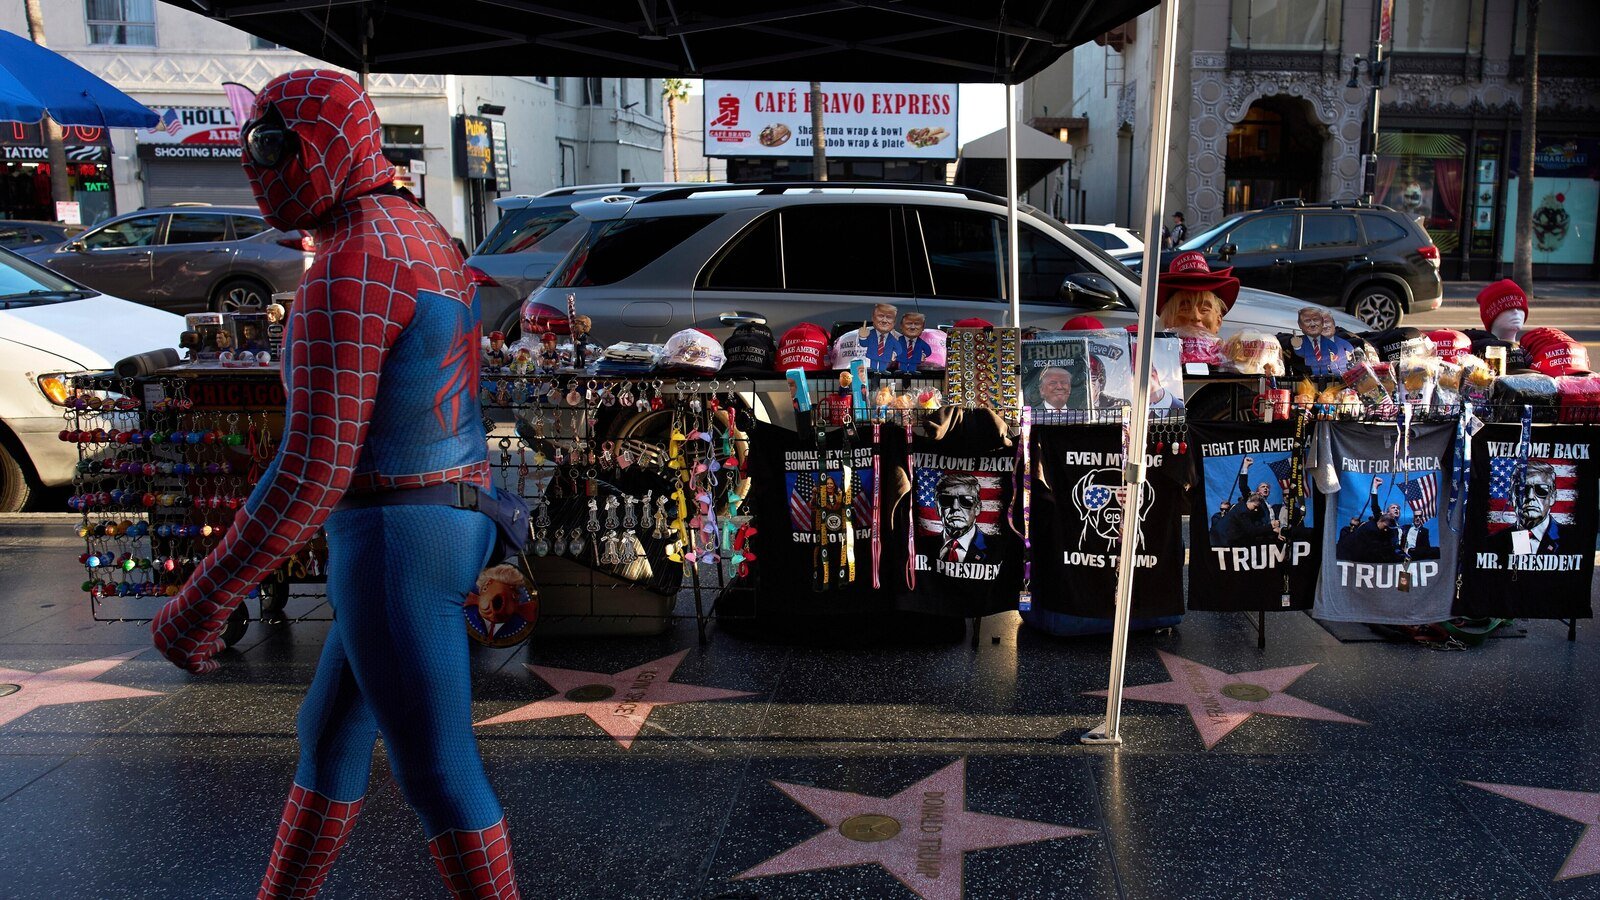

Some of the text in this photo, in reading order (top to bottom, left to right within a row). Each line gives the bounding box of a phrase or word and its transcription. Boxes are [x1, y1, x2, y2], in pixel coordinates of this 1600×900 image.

[755, 88, 797, 113] CAFÉ
[871, 93, 951, 115] EXPRESS
[208, 130, 241, 141] AIR
[798, 125, 903, 137] Shaerma wrap & bowl
[824, 138, 845, 147] abob
[847, 139, 870, 149] wrap
[872, 139, 879, 148] &
[882, 138, 905, 148] plate
[154, 147, 242, 158] SHOOTING RANG
[1497, 294, 1524, 305] AMERICA
[1504, 300, 1522, 309] AGAIN
[741, 346, 767, 357] AMERICA
[780, 345, 820, 357] MAKE AMERICA
[1024, 344, 1080, 360] TRUMP
[1088, 343, 1107, 354] lieve
[1383, 342, 1401, 353] MAKE
[1437, 349, 1456, 357] GREAT
[746, 355, 764, 364] AGAIN
[782, 355, 818, 365] GREAT AGAIN
[1545, 348, 1566, 360] MAKE
[1033, 359, 1075, 368] 2025 CALENDAR
[1549, 357, 1572, 368] GREAT
[189, 382, 280, 402] CHICAGO
[1296, 415, 1304, 438] RAMS
[1201, 434, 1312, 457] FIGHT FOR AMERA
[1553, 443, 1590, 460] BACK
[854, 447, 873, 458] GOT
[784, 460, 840, 471] SOMETNG
[854, 456, 873, 468] SAY
[912, 452, 1014, 473] WELCOME BACK
[1066, 451, 1102, 466] EVEN
[1145, 454, 1163, 468] OG
[1368, 459, 1390, 474] FOR
[792, 532, 812, 543] SAY
[1063, 551, 1158, 569] LOVES TMP
[1211, 541, 1311, 572] TRUMP
[1476, 552, 1583, 572] MR. PRESIDENT
[936, 558, 1003, 581] PRESIDEN
[1336, 561, 1439, 589] TRUMP
[916, 791, 945, 879] DONALD TRUMP
